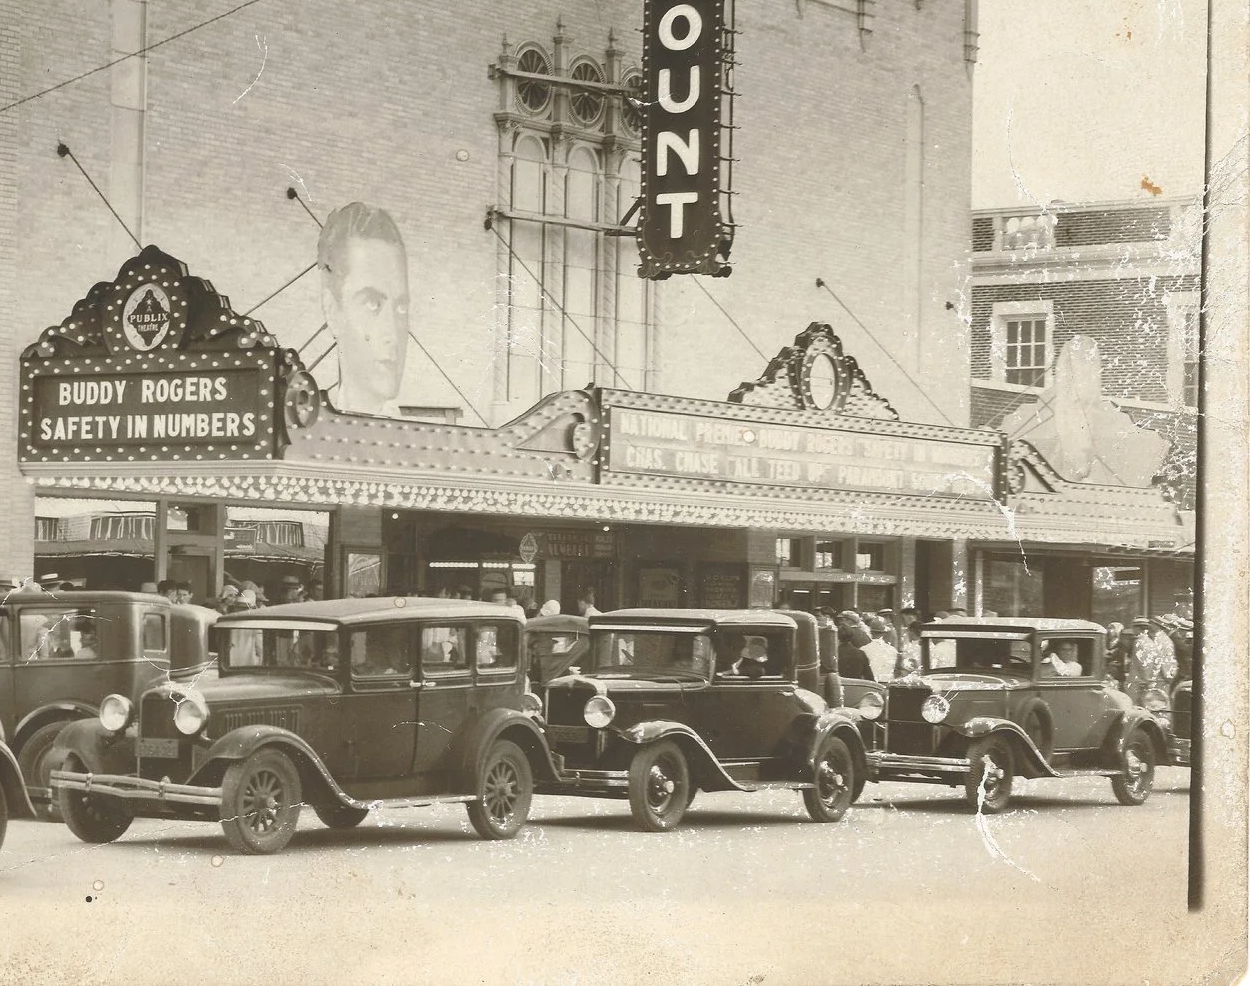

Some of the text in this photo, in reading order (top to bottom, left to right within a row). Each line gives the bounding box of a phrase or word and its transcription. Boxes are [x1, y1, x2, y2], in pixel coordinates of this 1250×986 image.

[130, 313, 168, 323] PUBLIX
[59, 377, 227, 405] BUDDY ROGERS
[40, 412, 255, 440] SAFETY IN NUMBERS
[620, 412, 688, 441] NATIONAL
[625, 440, 667, 470] CHAS.
[675, 450, 719, 474] CHASE
